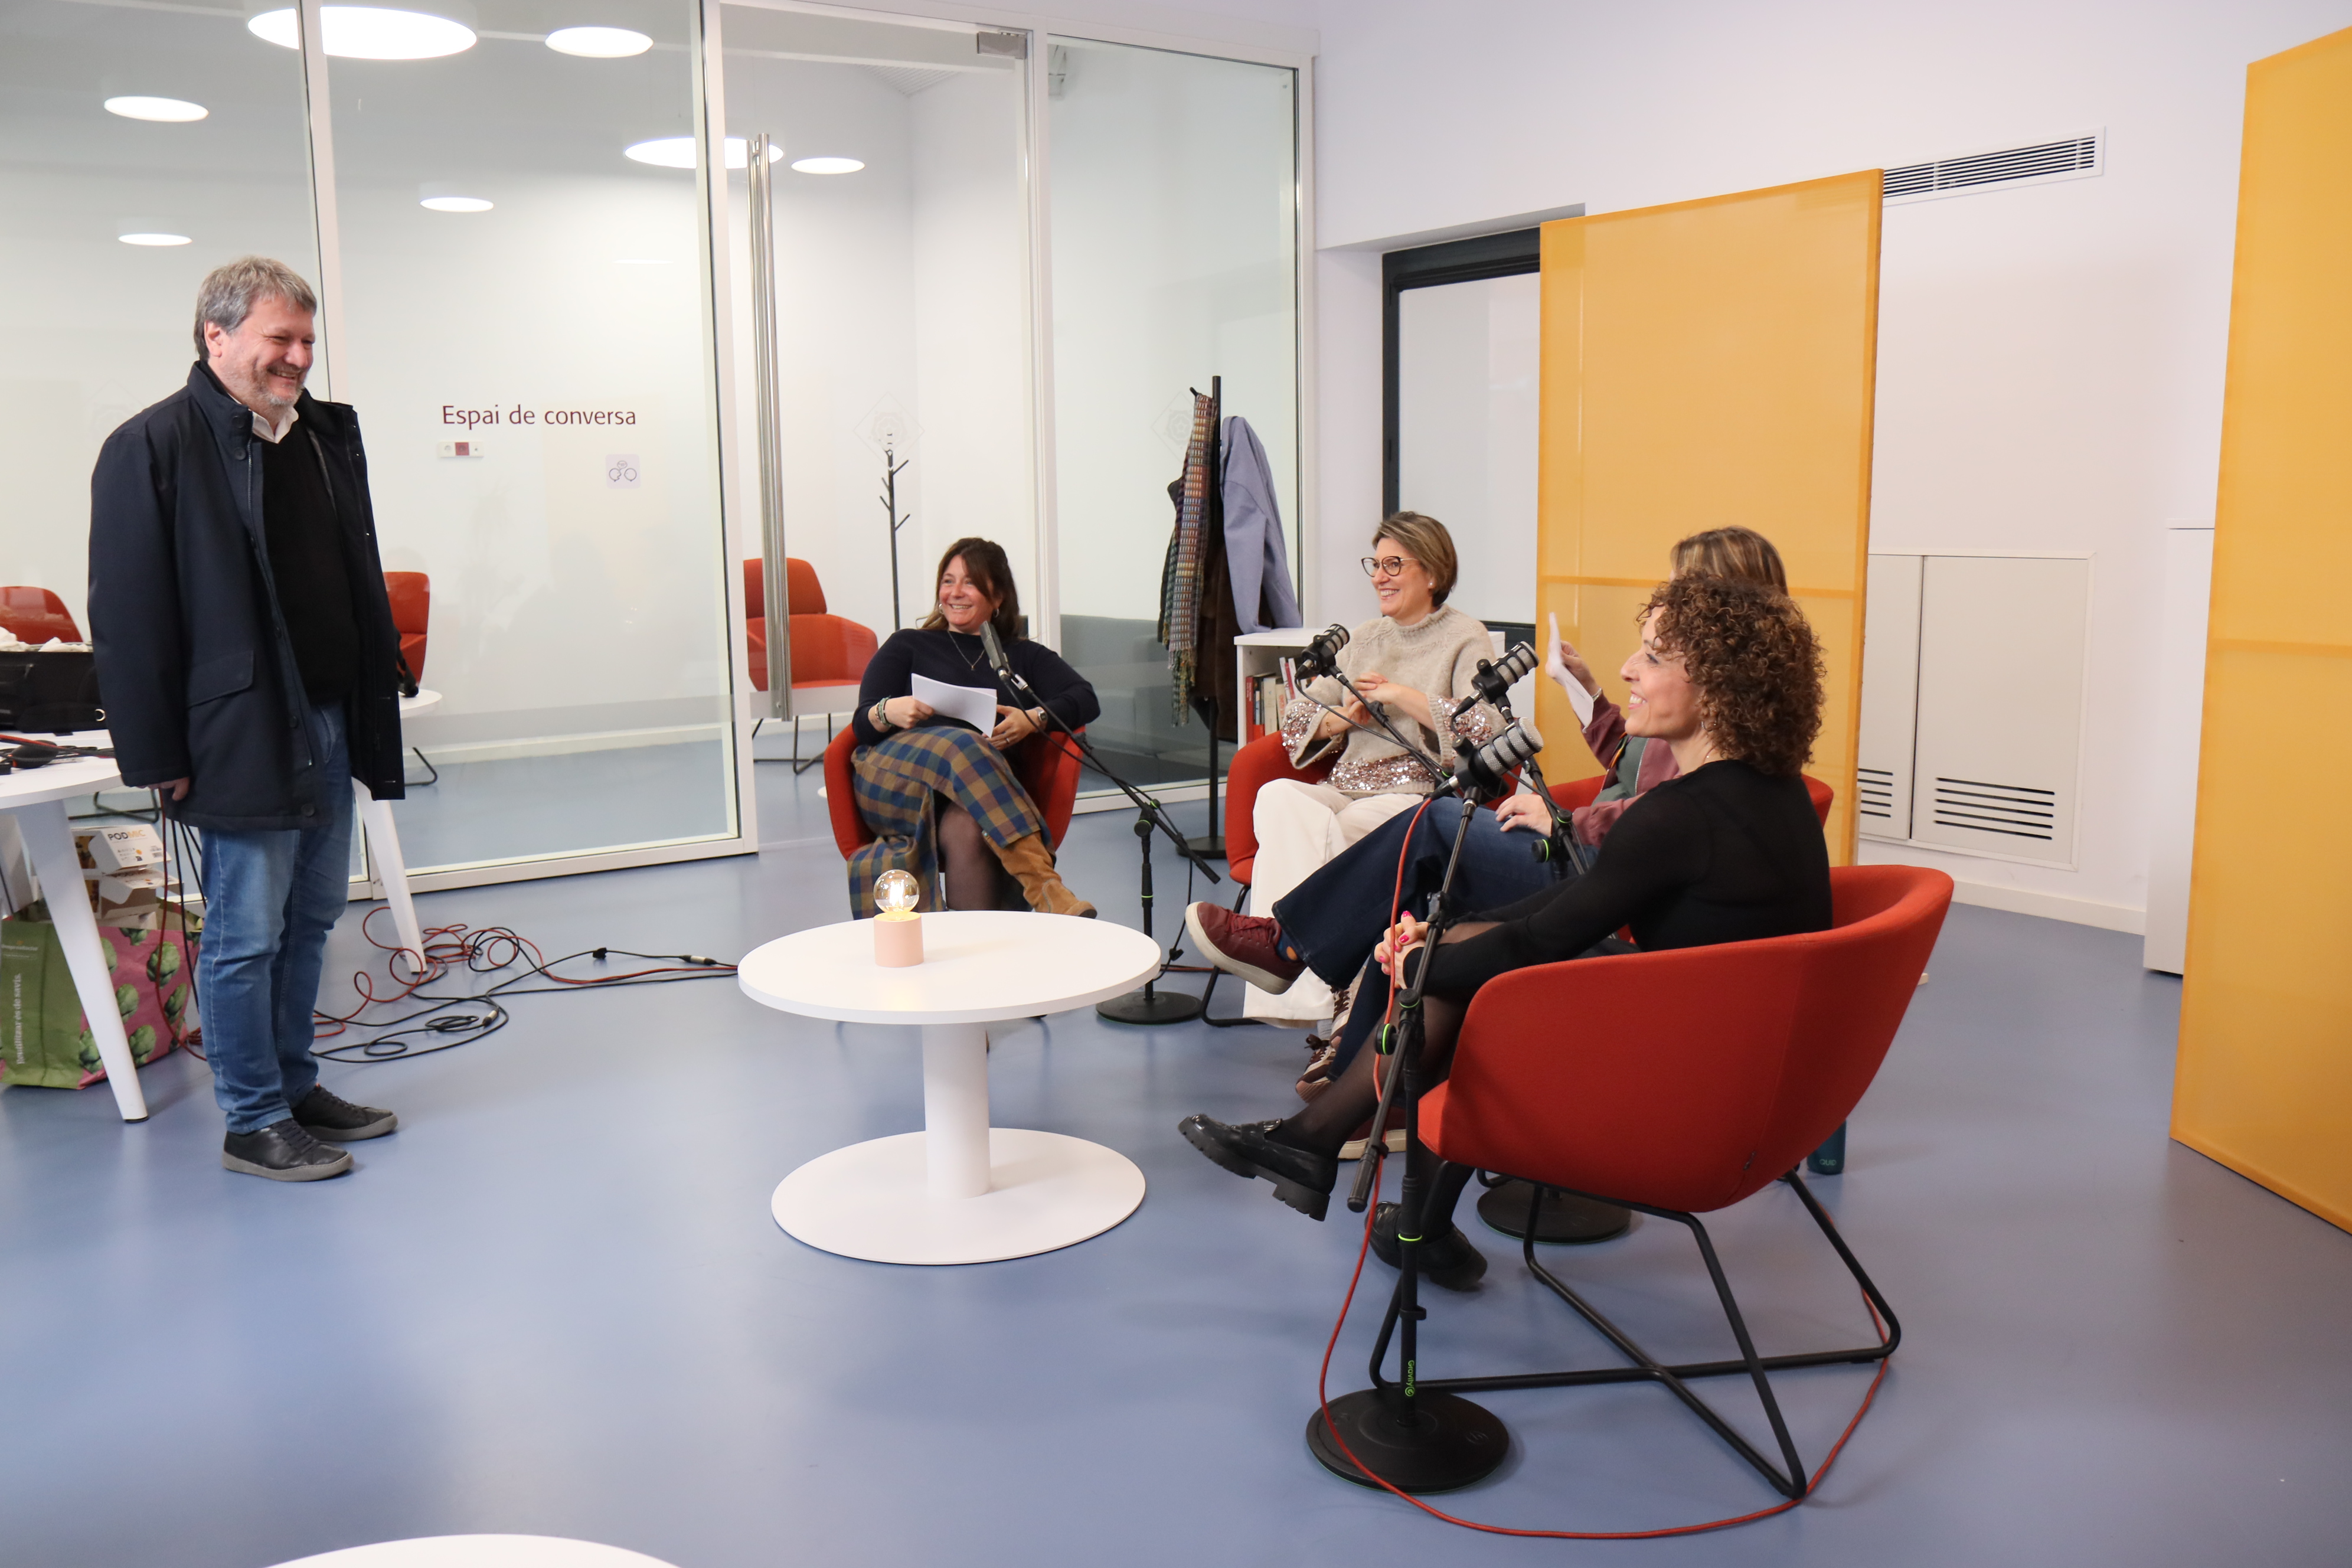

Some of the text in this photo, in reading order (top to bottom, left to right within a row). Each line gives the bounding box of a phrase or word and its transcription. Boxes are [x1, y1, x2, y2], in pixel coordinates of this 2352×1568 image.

[442, 404, 636, 430] Espai de conversa
[107, 829, 146, 840] PODMIC
[1406, 1360, 1415, 1387] Gravity
